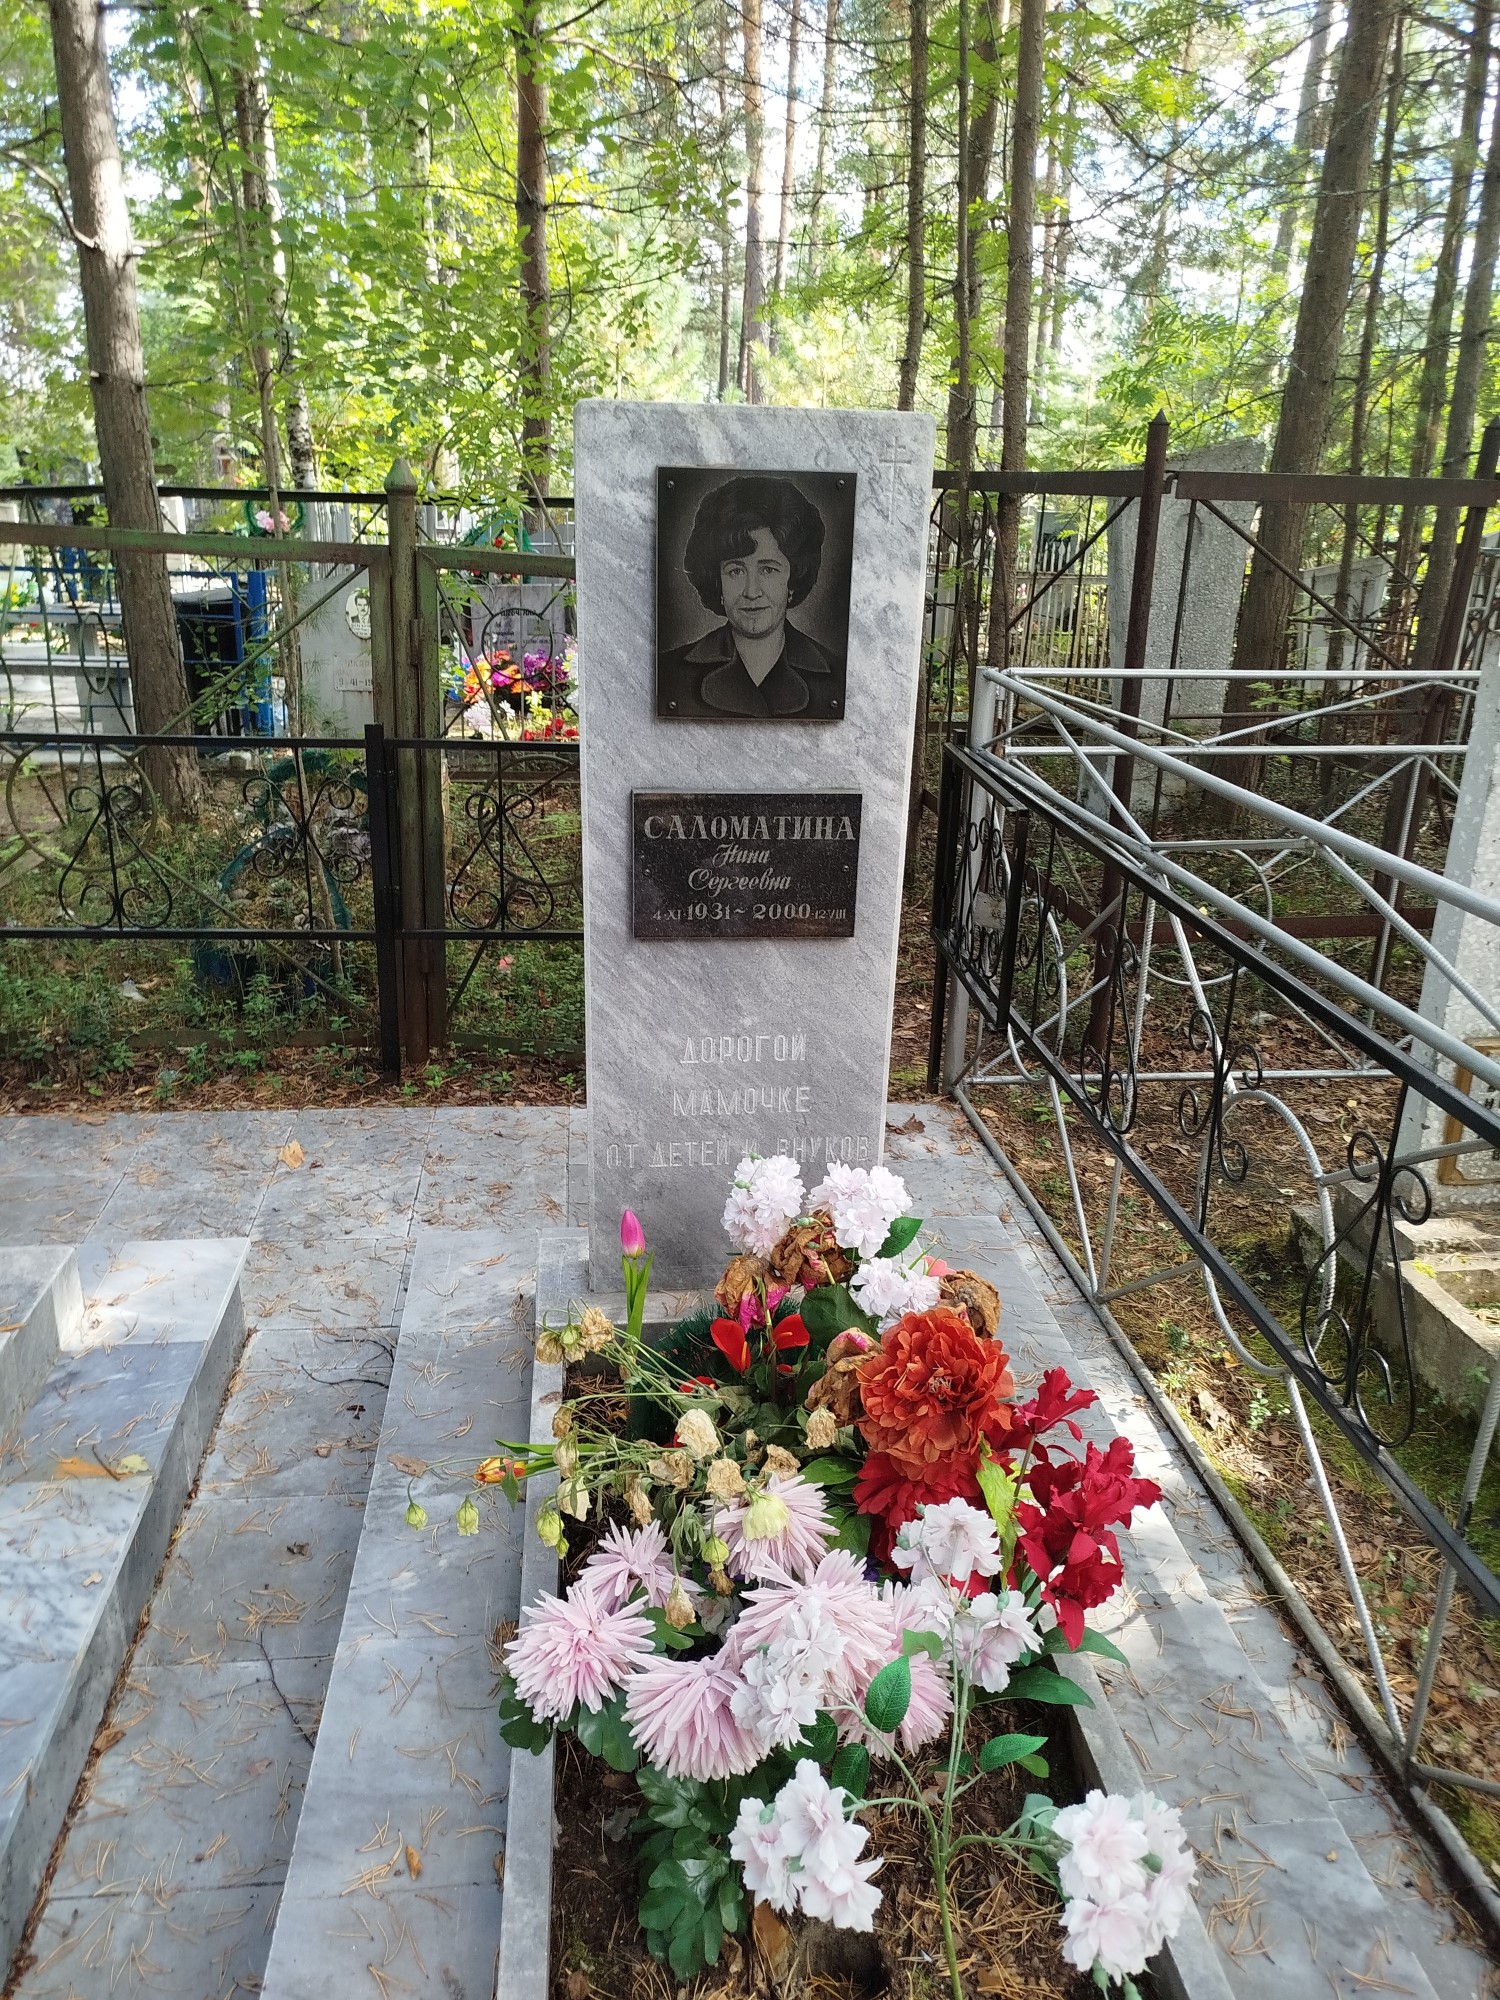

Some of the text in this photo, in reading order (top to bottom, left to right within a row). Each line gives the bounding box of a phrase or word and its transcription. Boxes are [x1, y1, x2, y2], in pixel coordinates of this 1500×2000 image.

[643, 815, 856, 841] САЛОМАТИНА
[713, 843, 771, 867] Нина
[688, 867, 792, 897] Сергеевна
[680, 1029, 807, 1064] ДОРОГОЙ
[673, 1086, 812, 1116] МАМОЧКЕ
[606, 1143, 639, 1169] ОТ
[649, 1135, 730, 1167] ДЕТЕЙ
[777, 1135, 870, 1163] ВНУКОВ
